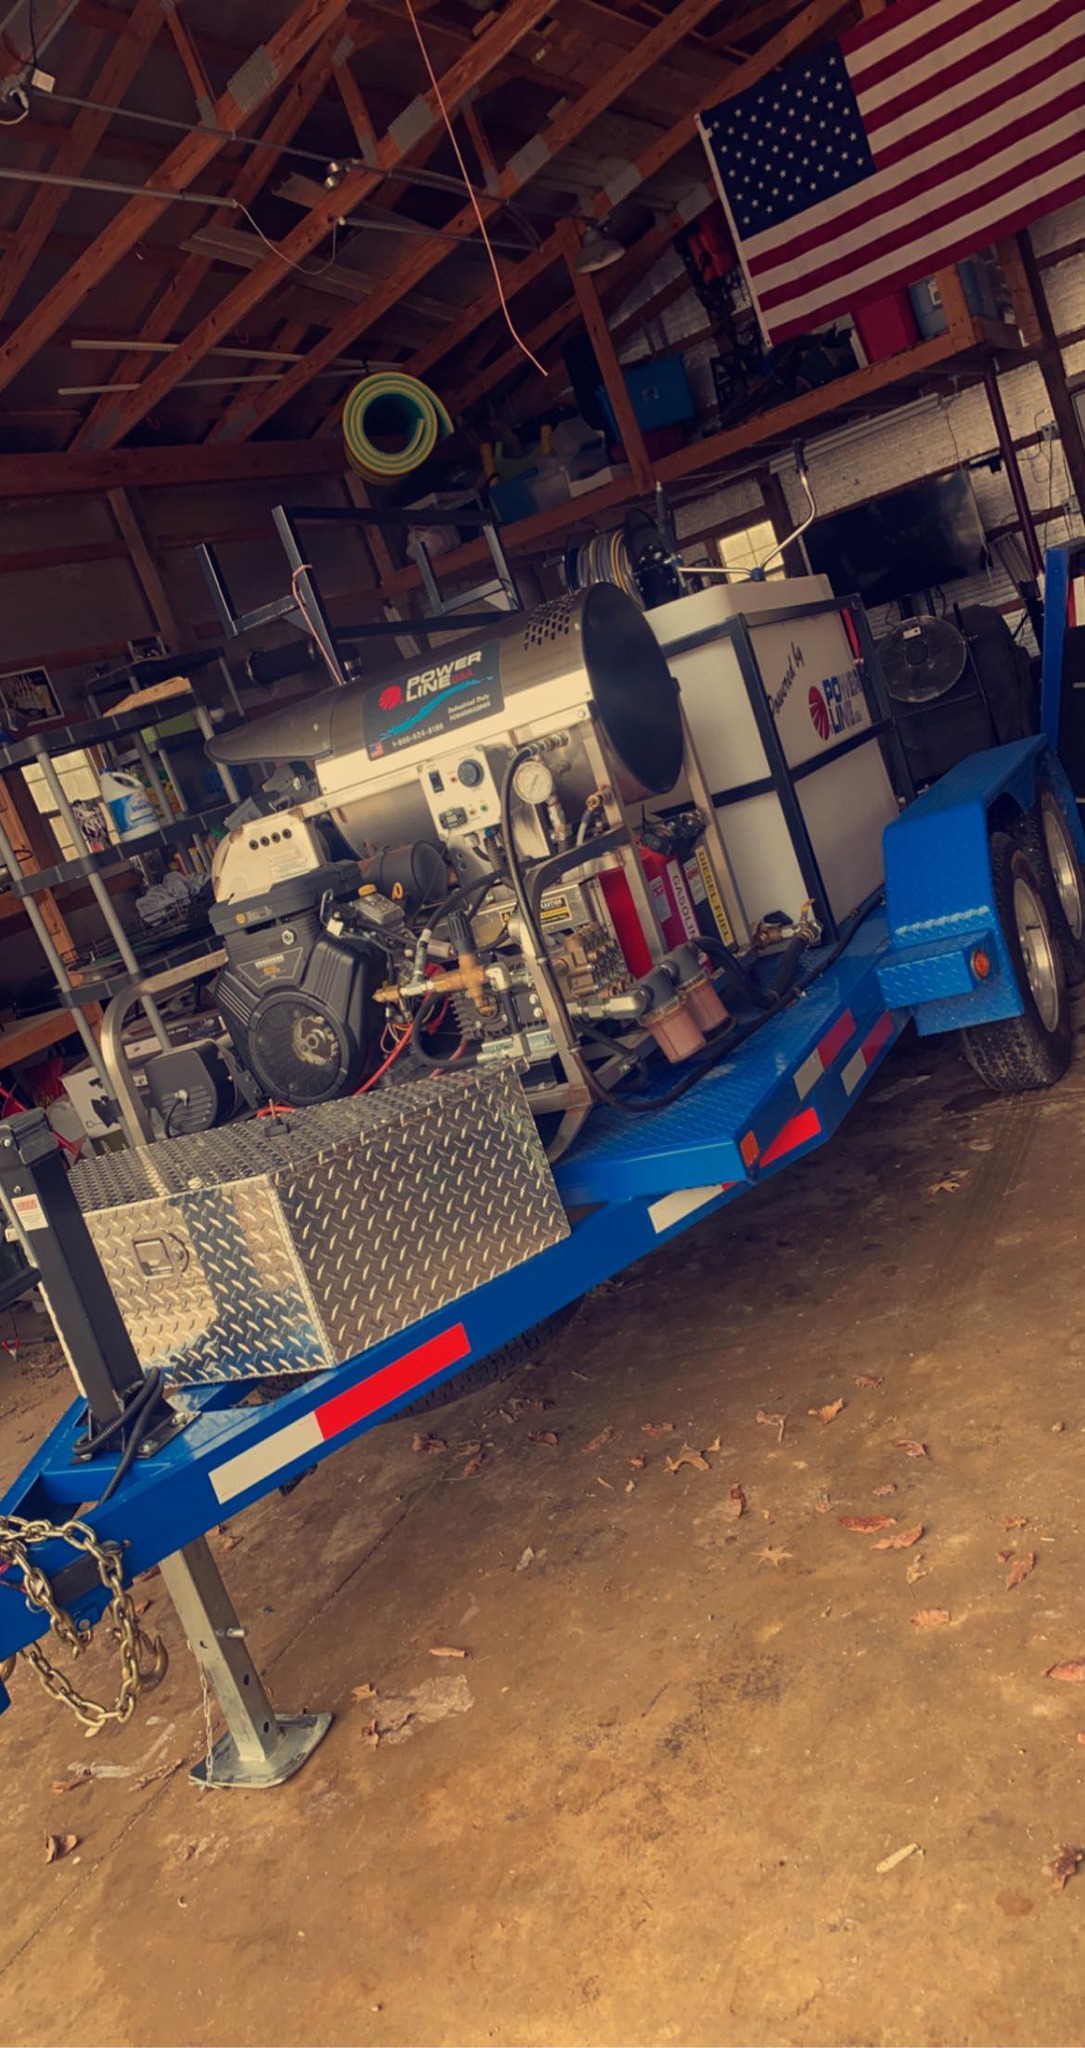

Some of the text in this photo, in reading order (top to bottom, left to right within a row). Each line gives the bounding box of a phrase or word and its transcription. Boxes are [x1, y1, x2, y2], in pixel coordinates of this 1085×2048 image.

[406, 650, 482, 689] POWER
[406, 674, 452, 702] LINE
[673, 876, 696, 936] GASOLIN
[699, 852, 731, 938] DIESEL FUEL
